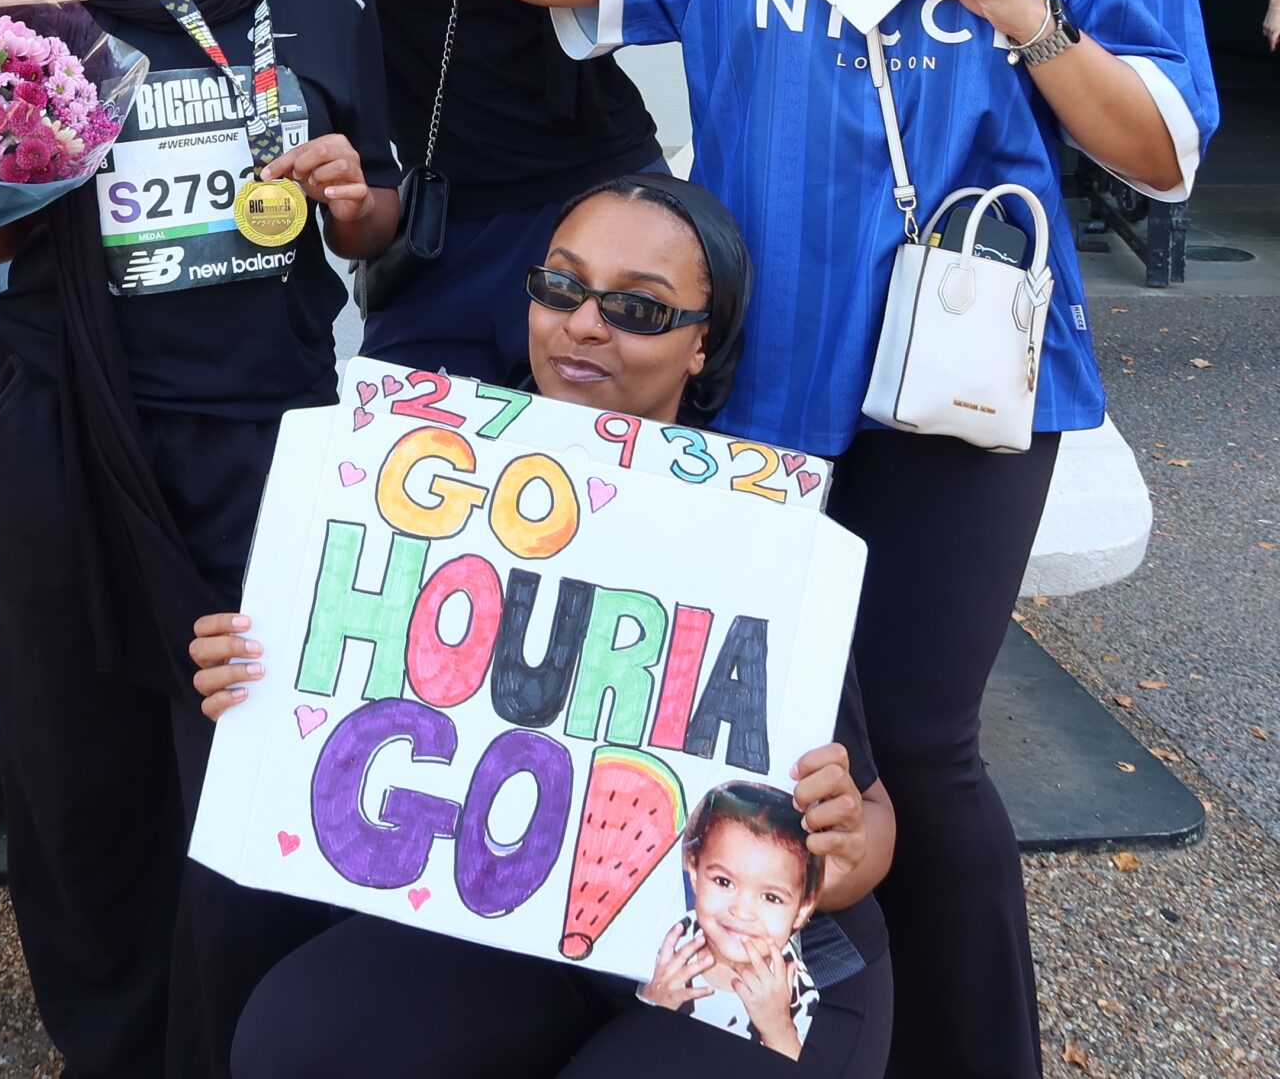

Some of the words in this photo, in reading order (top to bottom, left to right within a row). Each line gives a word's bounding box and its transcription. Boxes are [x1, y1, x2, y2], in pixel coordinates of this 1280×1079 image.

[836, 53, 937, 71] LODON
[158, 132, 239, 150] #WERUNASONE
[288, 131, 300, 147] U
[249, 199, 264, 214] BIG
[138, 231, 166, 242] MEDAL
[188, 262, 228, 281] new
[375, 425, 581, 560] GO
[294, 520, 770, 775] HOURIA
